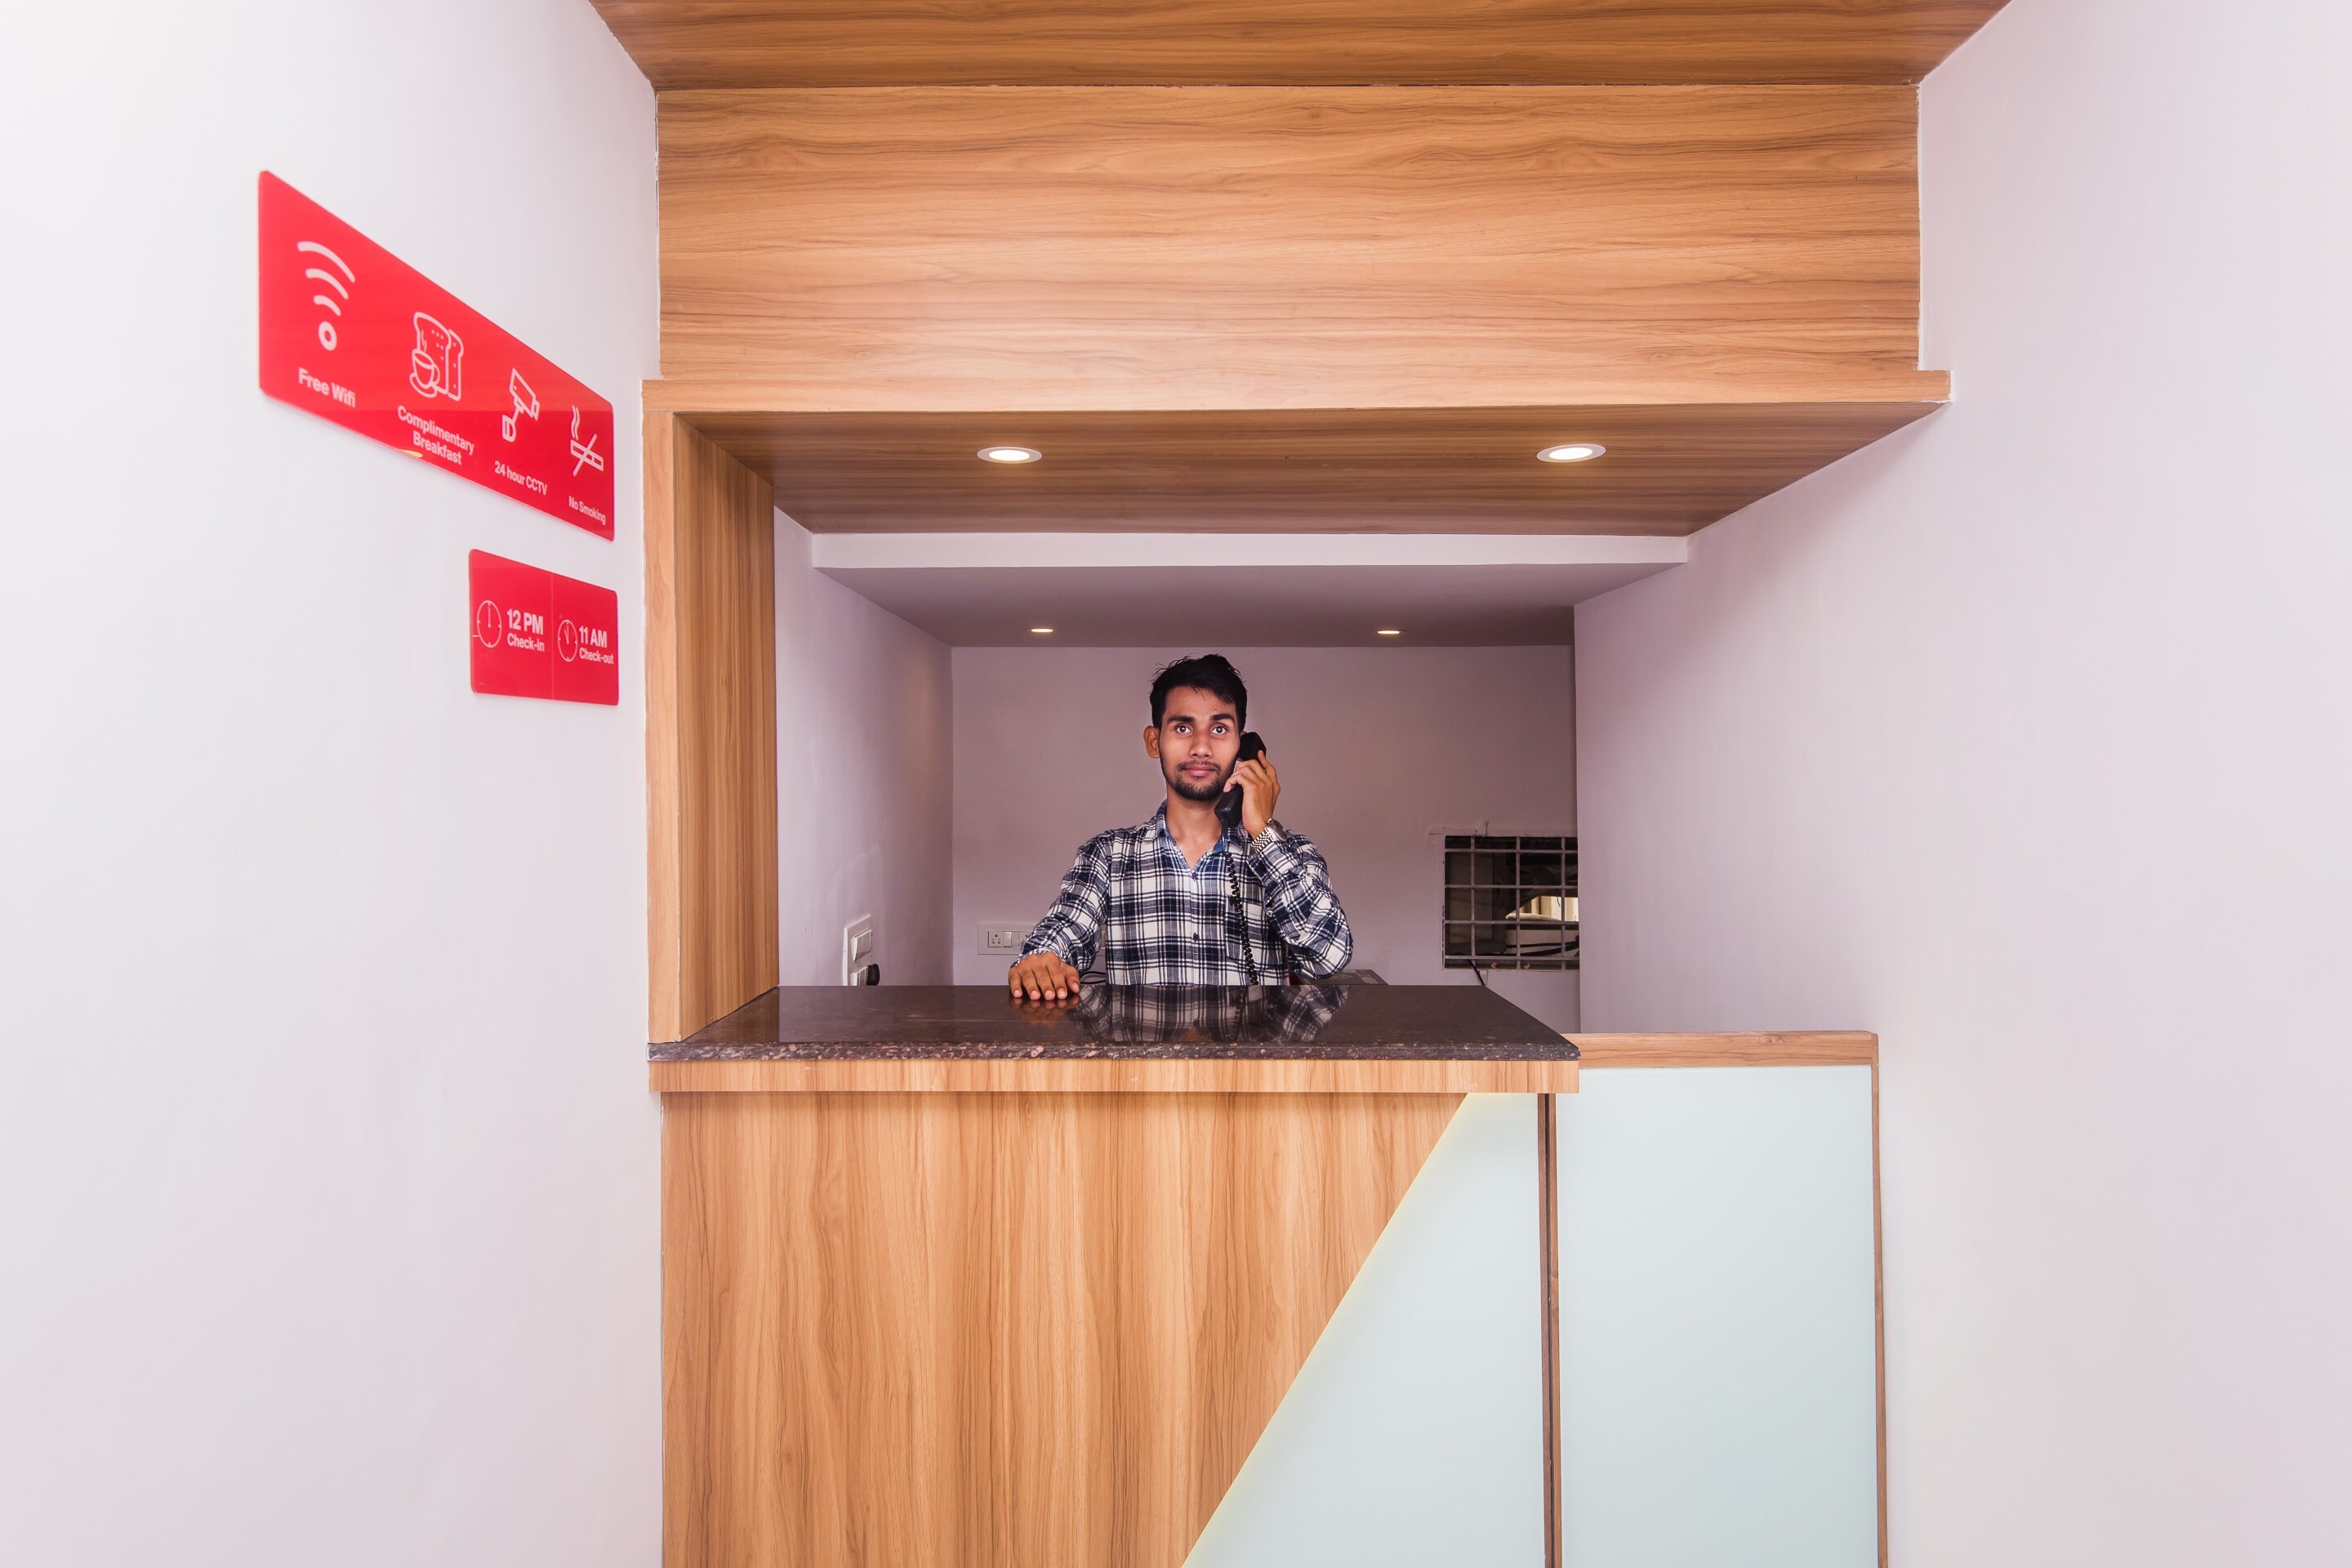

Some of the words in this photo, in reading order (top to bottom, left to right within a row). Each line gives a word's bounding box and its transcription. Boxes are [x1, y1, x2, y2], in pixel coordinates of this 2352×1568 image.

[298, 367, 330, 395] Free
[331, 381, 356, 408] Wifi
[397, 405, 475, 456] Complimentary
[412, 430, 462, 466] Breakfast
[494, 460, 506, 477] 24
[506, 466, 525, 486] hour
[526, 475, 548, 495] CCTV
[568, 495, 579, 510] No
[578, 501, 607, 525] Smoking
[506, 608, 521, 630] 12
[523, 612, 544, 635] PM
[506, 632, 545, 652] Check-in
[579, 626, 588, 644] 11
[590, 628, 608, 648] AM
[579, 647, 614, 665] Check-out
